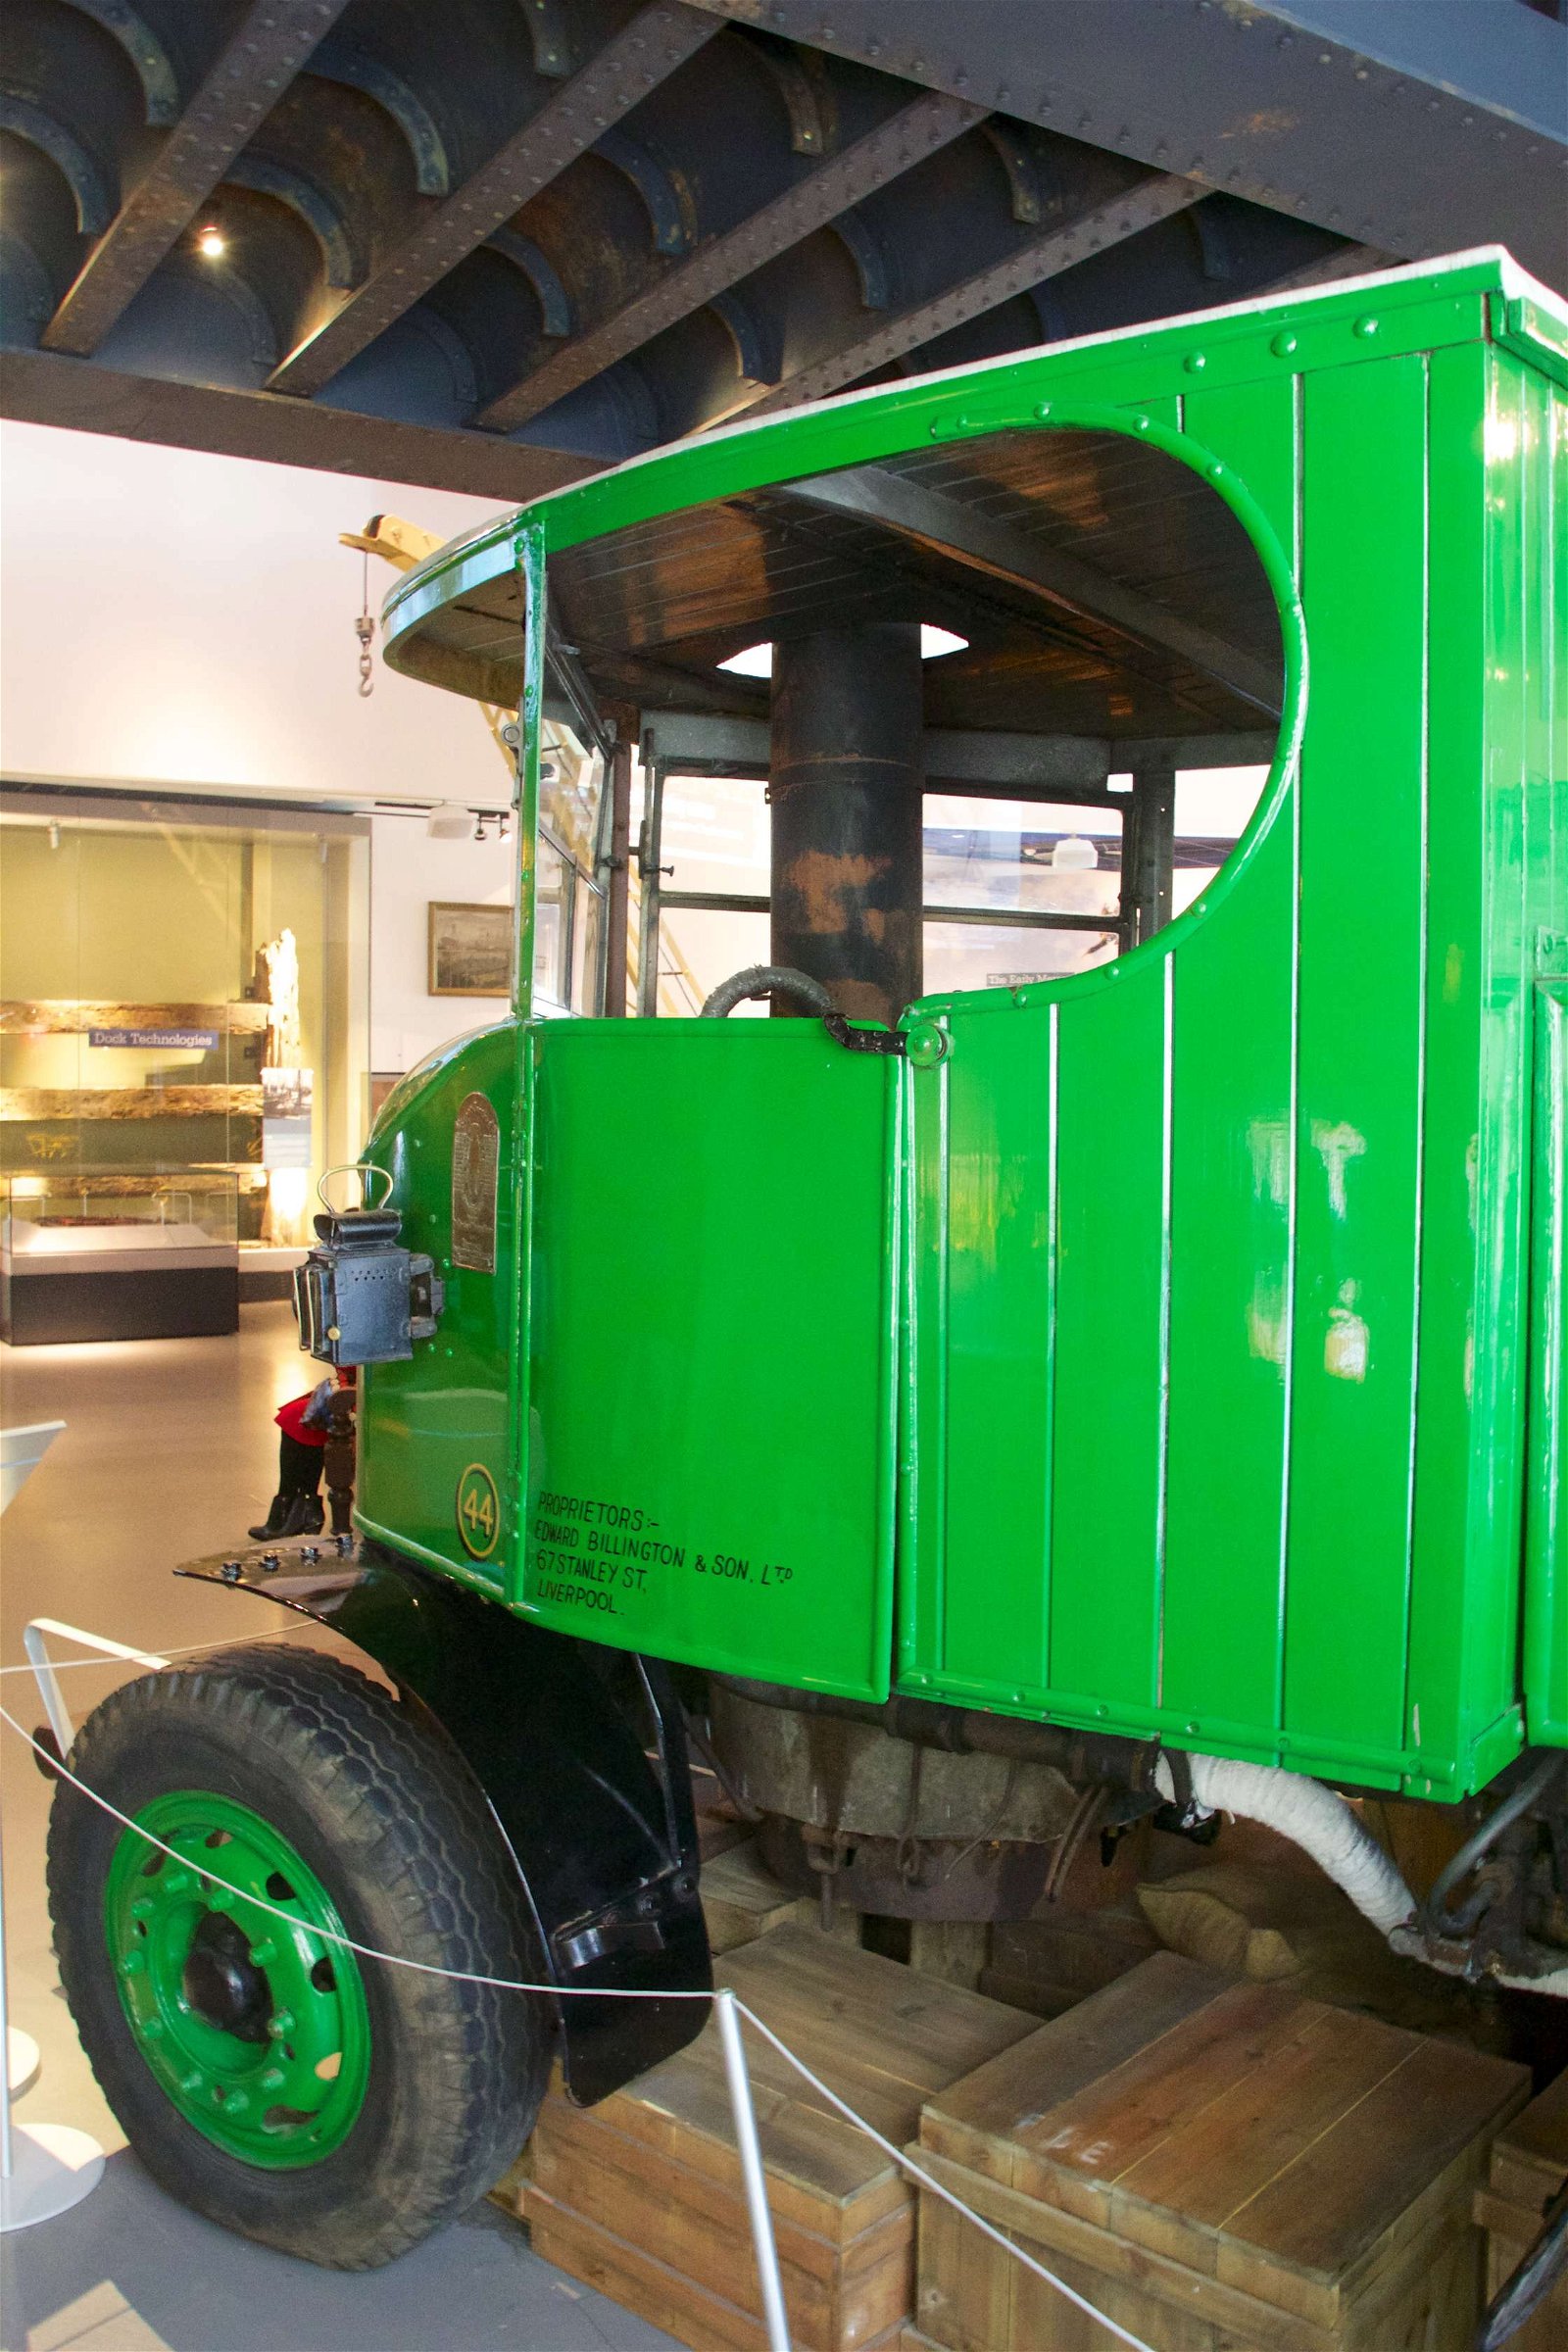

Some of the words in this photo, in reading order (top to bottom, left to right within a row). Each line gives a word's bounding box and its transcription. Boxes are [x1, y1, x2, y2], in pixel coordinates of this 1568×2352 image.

[93, 1031, 126, 1046] Dock
[129, 1031, 213, 1048] Technologies
[464, 1489, 494, 1538] 44
[533, 1519, 579, 1547] EDWARD
[587, 1531, 686, 1568] BILLINGTON
[694, 1554, 708, 1574] &
[536, 1548, 556, 1571] 67
[557, 1553, 619, 1584] STANLEY
